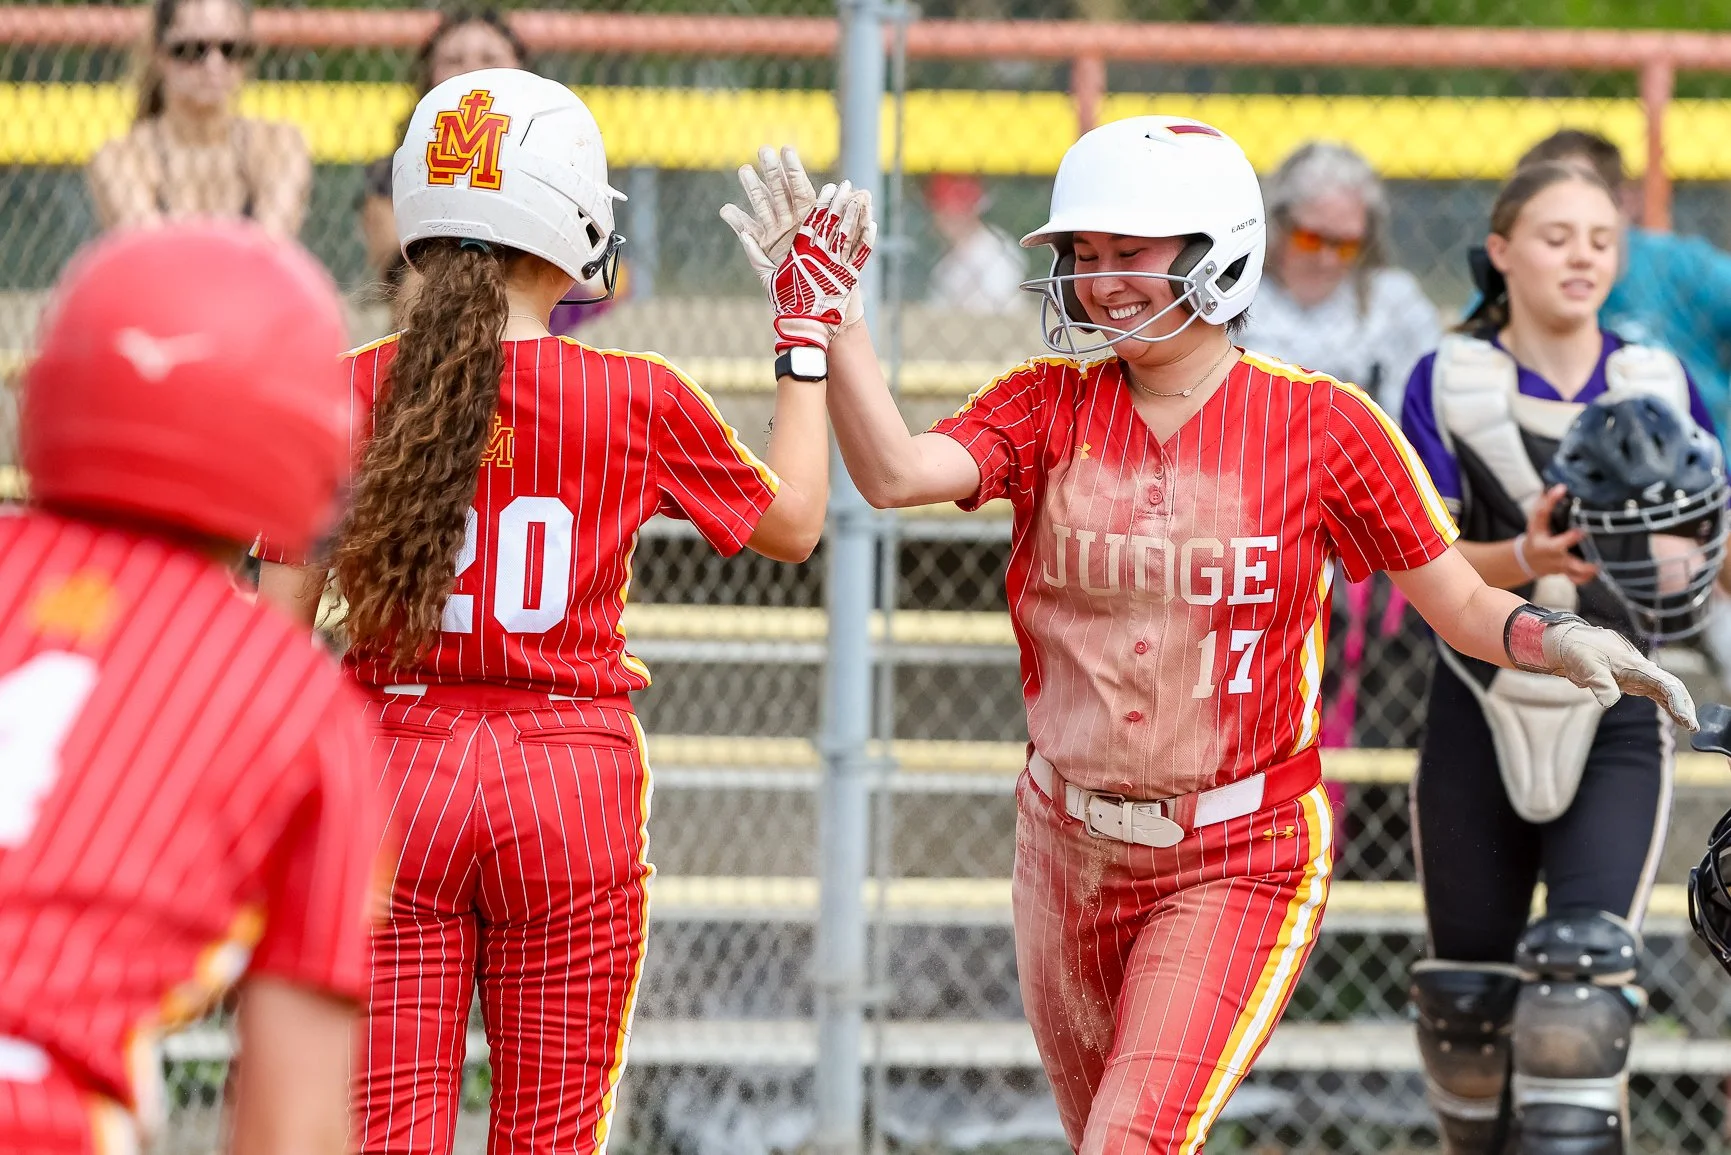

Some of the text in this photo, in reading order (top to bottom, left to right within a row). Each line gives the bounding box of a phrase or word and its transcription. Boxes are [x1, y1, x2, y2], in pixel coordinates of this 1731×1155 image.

[1231, 217, 1257, 233] EASTON
[441, 495, 574, 634] 0
[1042, 524, 1278, 606] JUDGE
[1191, 628, 1266, 700] 17
